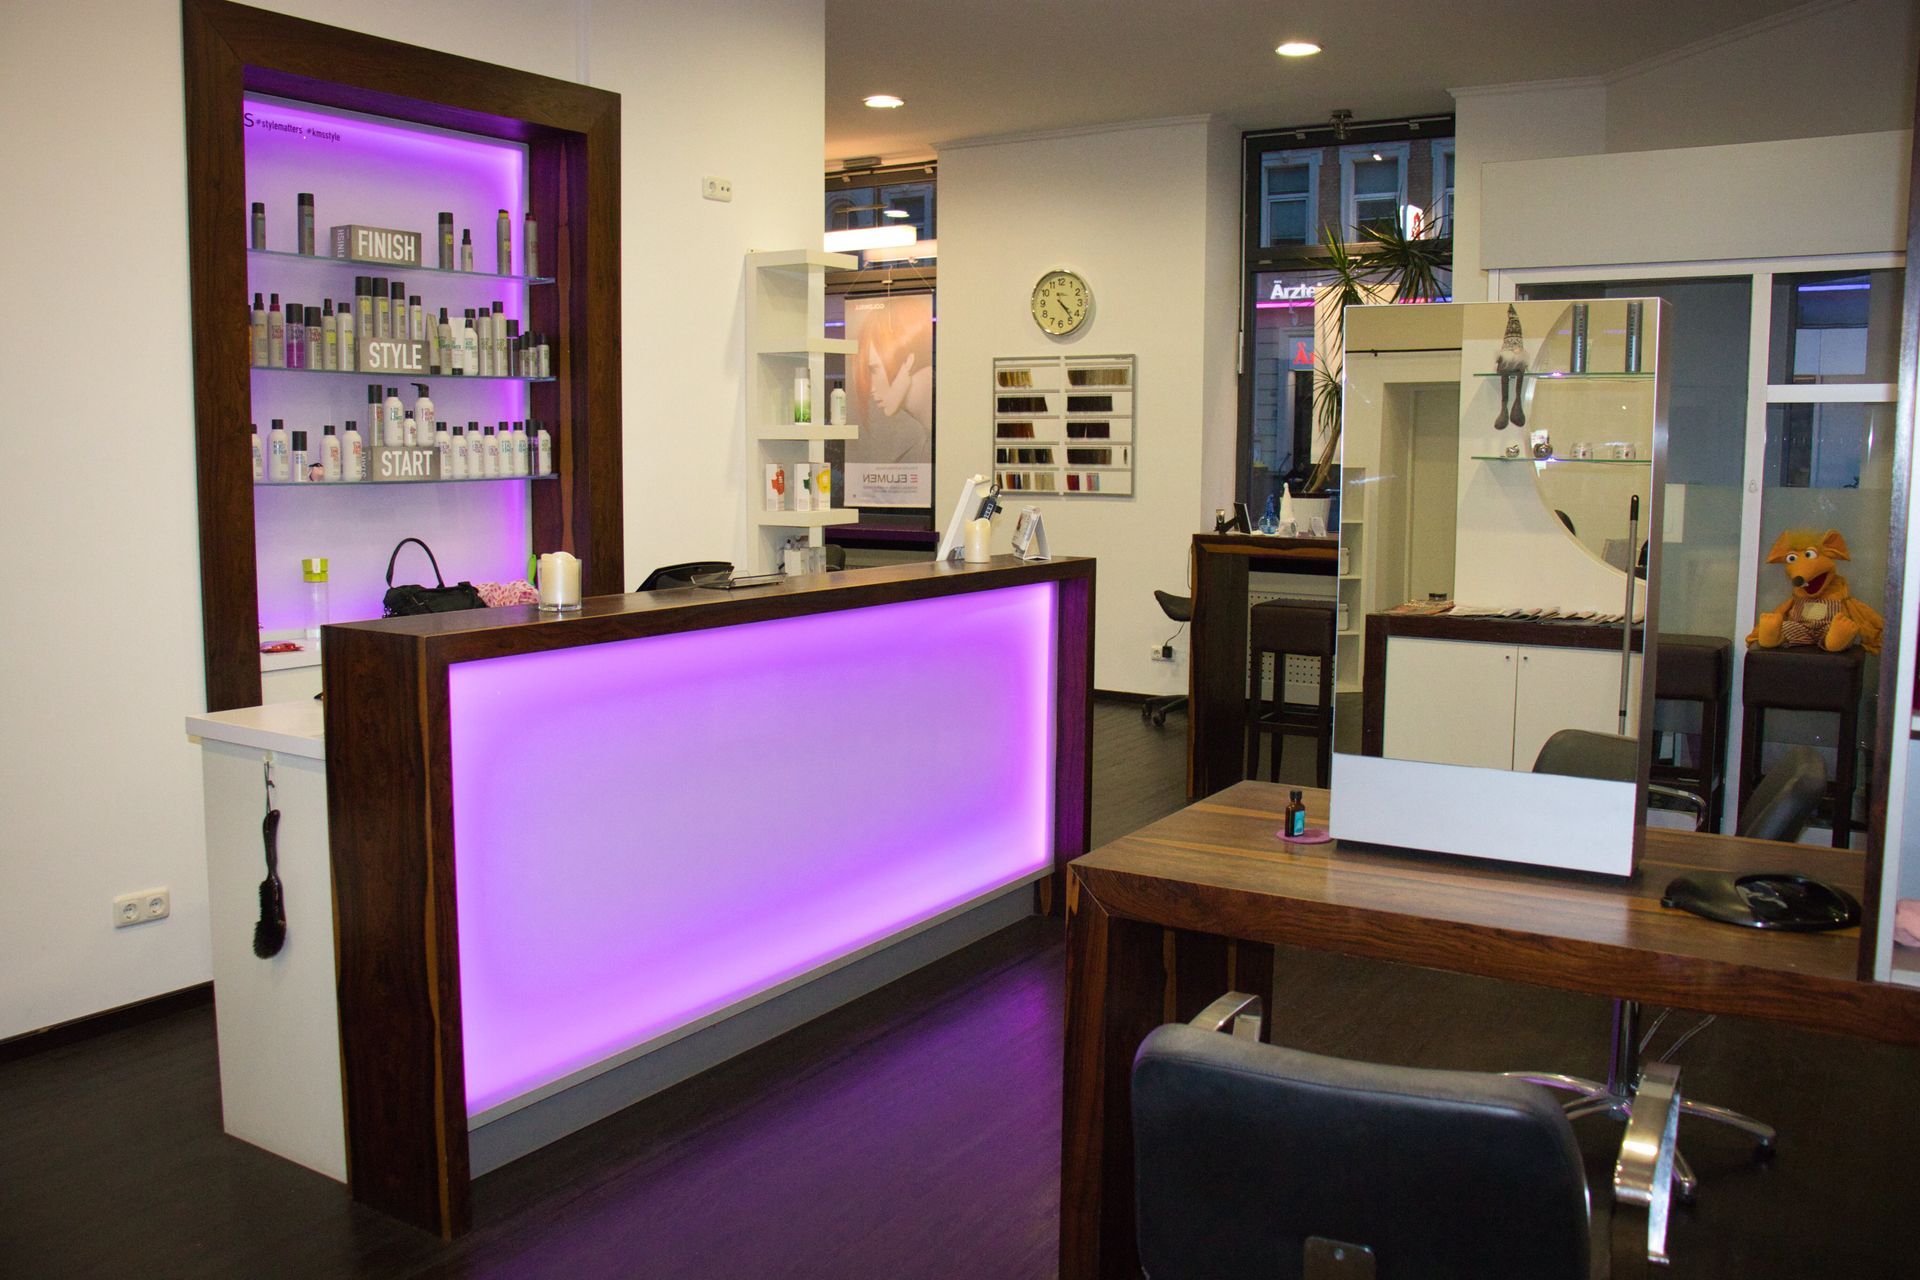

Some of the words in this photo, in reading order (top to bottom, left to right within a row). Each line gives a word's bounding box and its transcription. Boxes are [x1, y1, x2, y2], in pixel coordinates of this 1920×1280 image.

[337, 229, 345, 258] FINISH
[358, 229, 415, 262] FINISH
[1049, 281, 1056, 289] 11
[1057, 277, 1066, 287] 12
[1069, 280, 1073, 289] 1
[1041, 288, 1050, 297] 10
[1075, 287, 1081, 297] 2
[1040, 299, 1046, 308] 9
[1077, 298, 1083, 307] 3
[1042, 309, 1048, 319] 8
[1073, 309, 1080, 317] 4
[1049, 317, 1055, 326] 7
[1057, 319, 1064, 329] 6
[369, 341, 423, 369] STYLE
[381, 450, 433, 477] START
